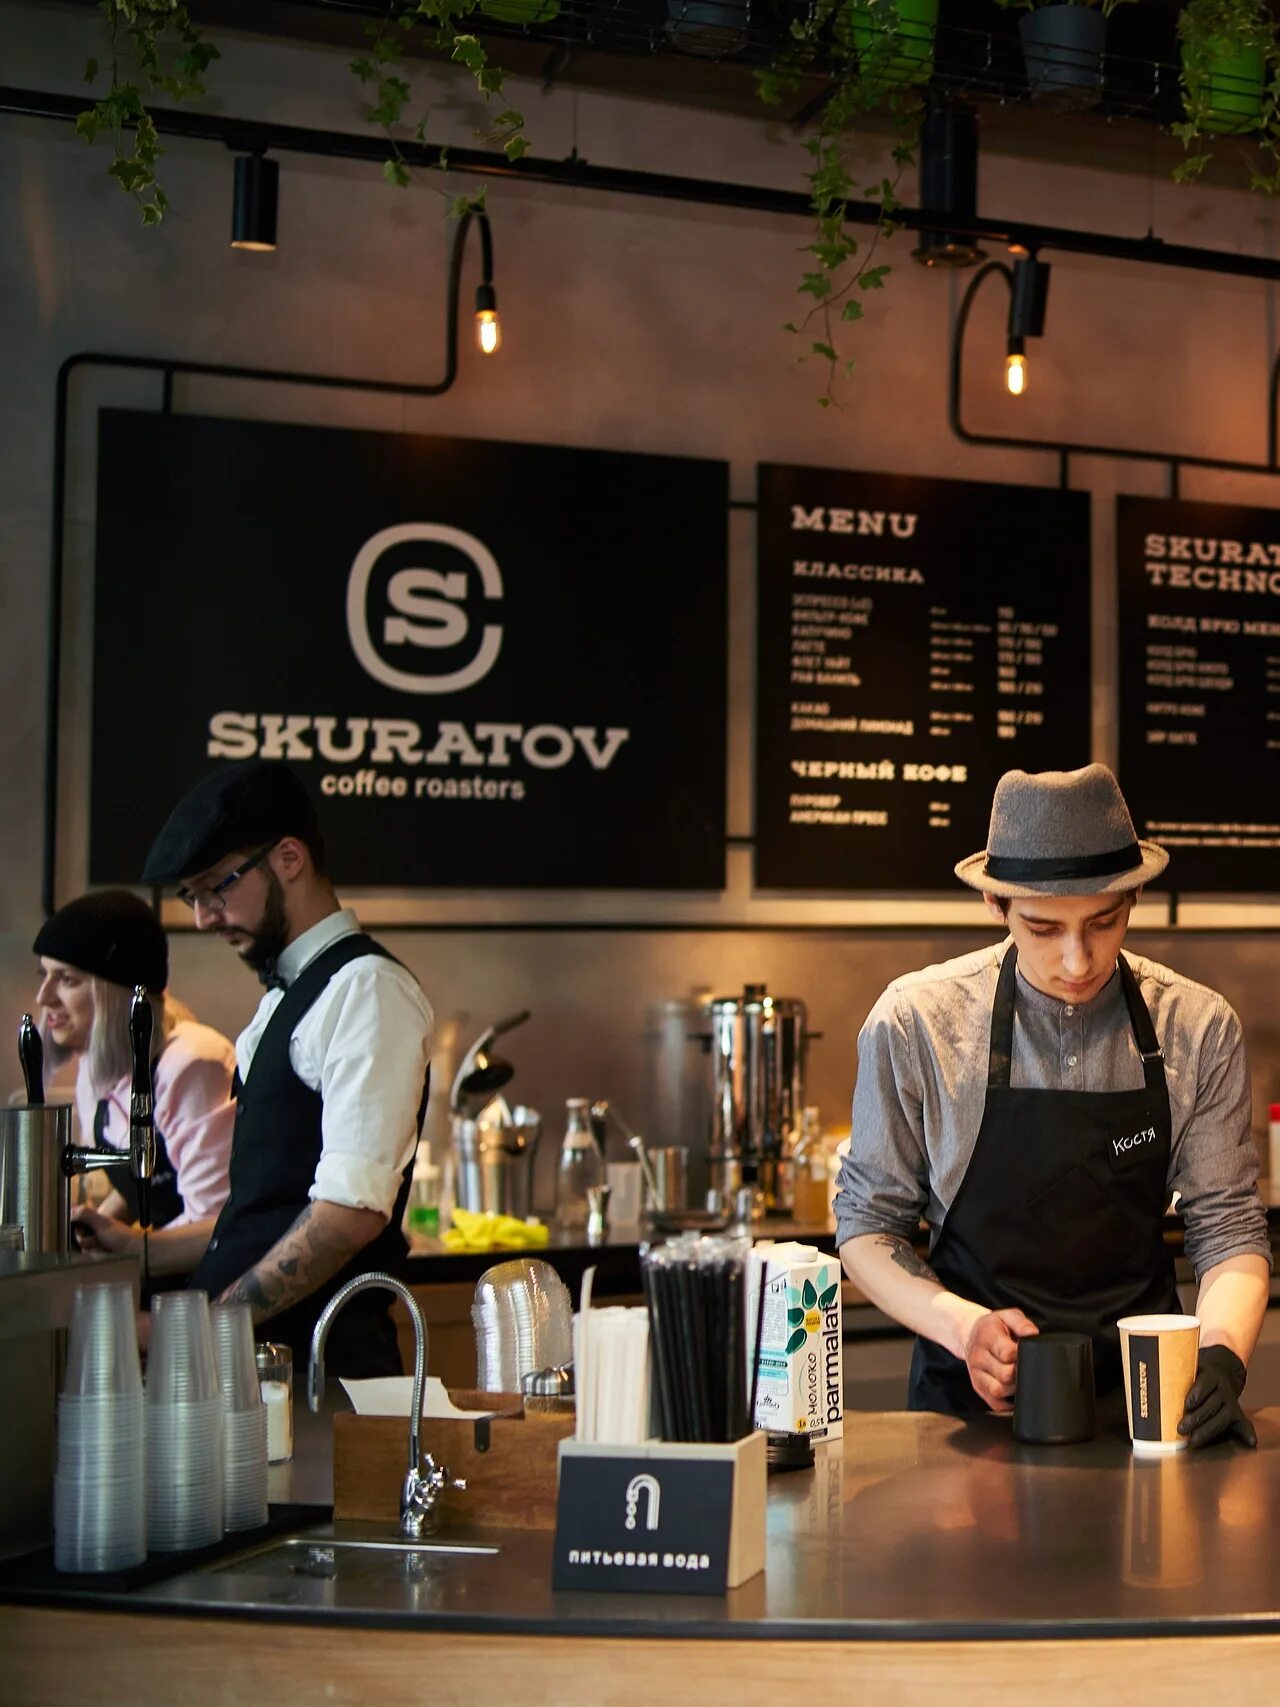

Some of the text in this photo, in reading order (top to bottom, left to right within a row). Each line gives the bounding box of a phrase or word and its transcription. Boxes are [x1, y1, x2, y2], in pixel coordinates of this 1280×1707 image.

[790, 505, 918, 538] MENU
[793, 561, 925, 584] КЛАССИКА
[207, 712, 629, 769] SKURATOV
[320, 770, 525, 800] coffee roasters
[790, 759, 967, 782] ЧЕРНЫЙ КОФЕ
[822, 1301, 843, 1424] parmalat
